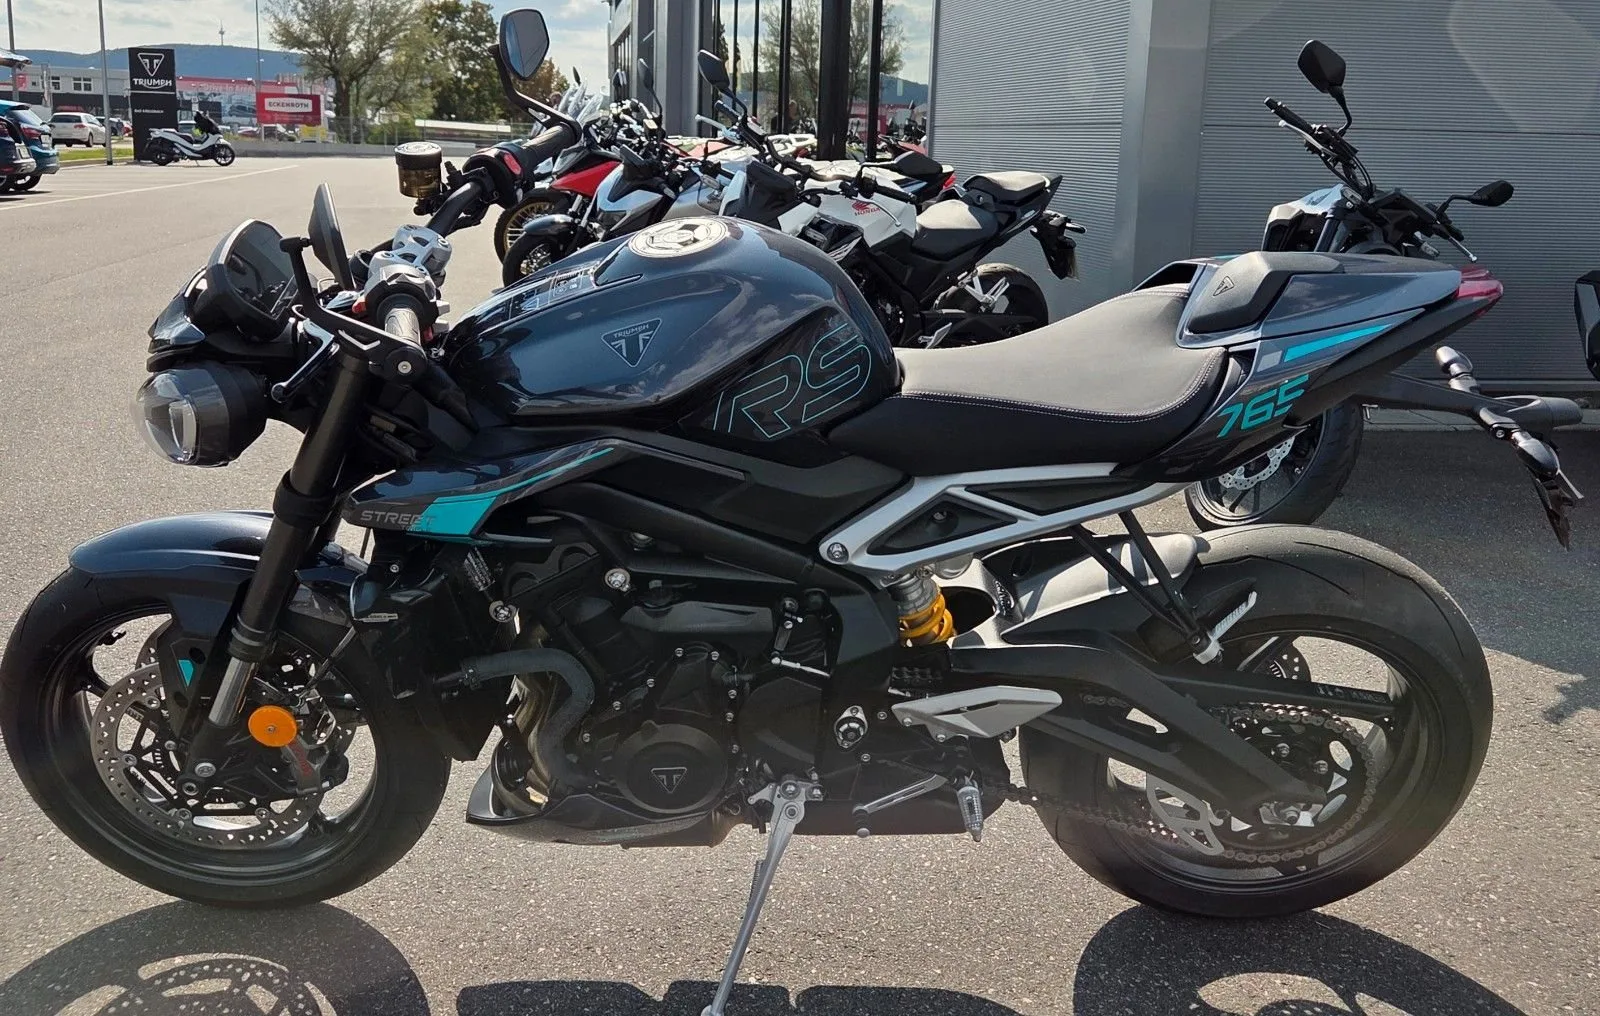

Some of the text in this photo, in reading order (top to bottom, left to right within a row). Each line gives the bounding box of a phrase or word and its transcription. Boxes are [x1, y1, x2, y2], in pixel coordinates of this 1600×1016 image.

[132, 78, 172, 88] TRIUMPH
[854, 207, 881, 216] HONDA
[613, 323, 650, 339] TRIUMPH
[713, 322, 873, 439] RS
[1216, 373, 1309, 439] 765
[360, 510, 436, 527] STREET
